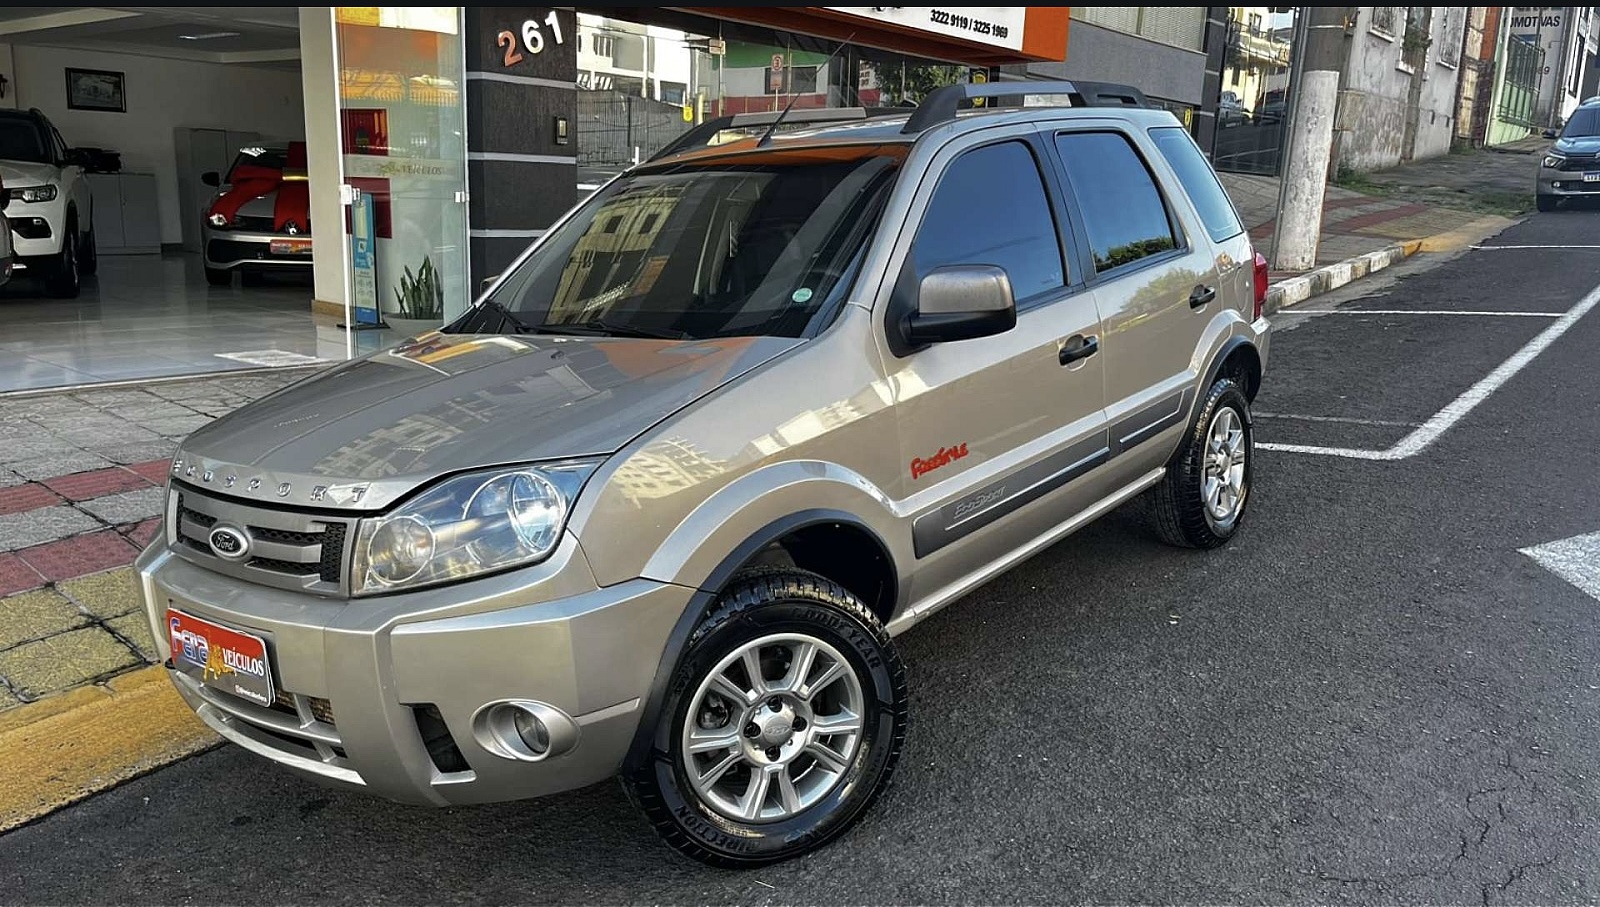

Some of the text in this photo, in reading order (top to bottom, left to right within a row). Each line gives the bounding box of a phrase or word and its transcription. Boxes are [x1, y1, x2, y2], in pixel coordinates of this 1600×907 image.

[930, 9, 950, 25] 3222
[950, 14, 968, 30] 9119
[973, 19, 991, 35] 3225
[497, 10, 563, 67] 261
[217, 534, 235, 550] Ford
[222, 646, 265, 677] VEÍCULOS
